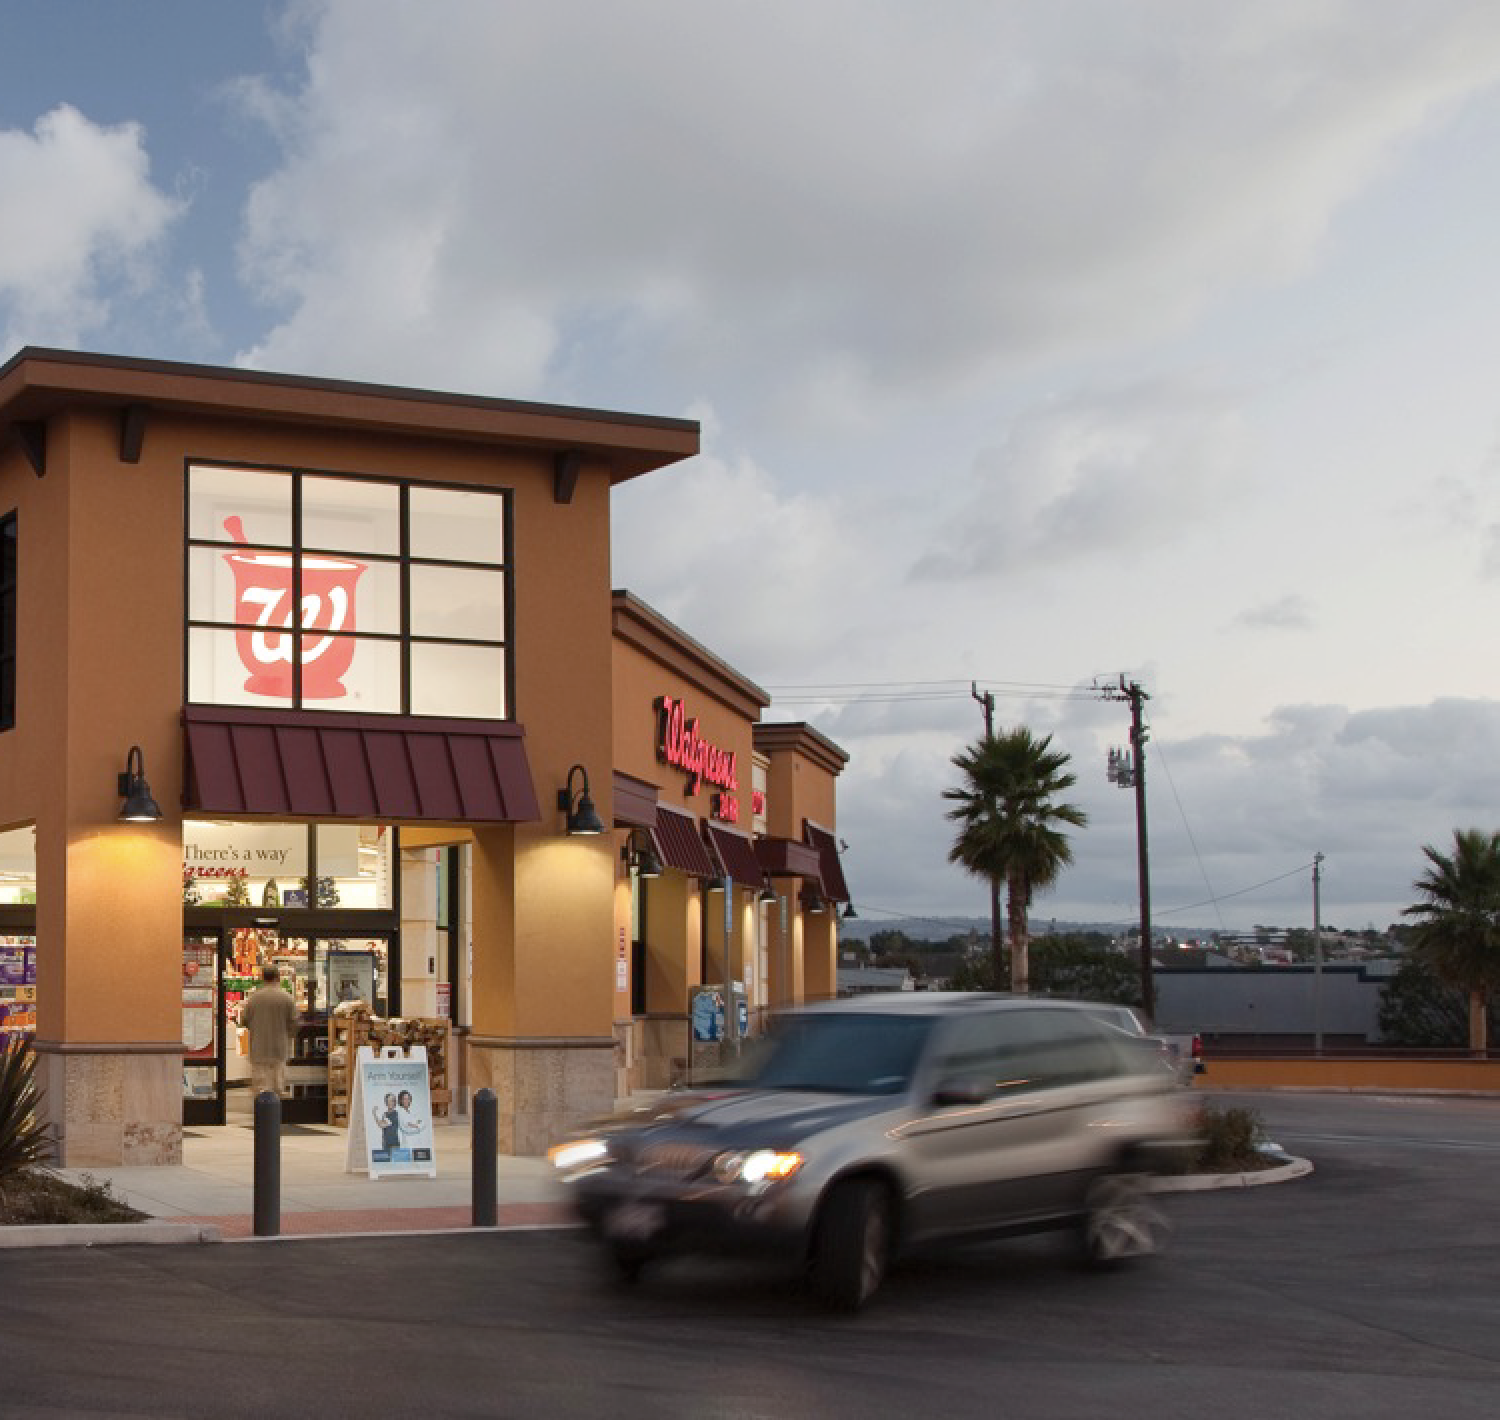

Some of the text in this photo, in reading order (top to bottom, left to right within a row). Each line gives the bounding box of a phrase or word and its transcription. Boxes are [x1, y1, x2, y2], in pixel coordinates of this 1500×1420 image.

[661, 695, 739, 796] Walgreens
[184, 843, 288, 866] There's a way
[182, 863, 249, 877] greens
